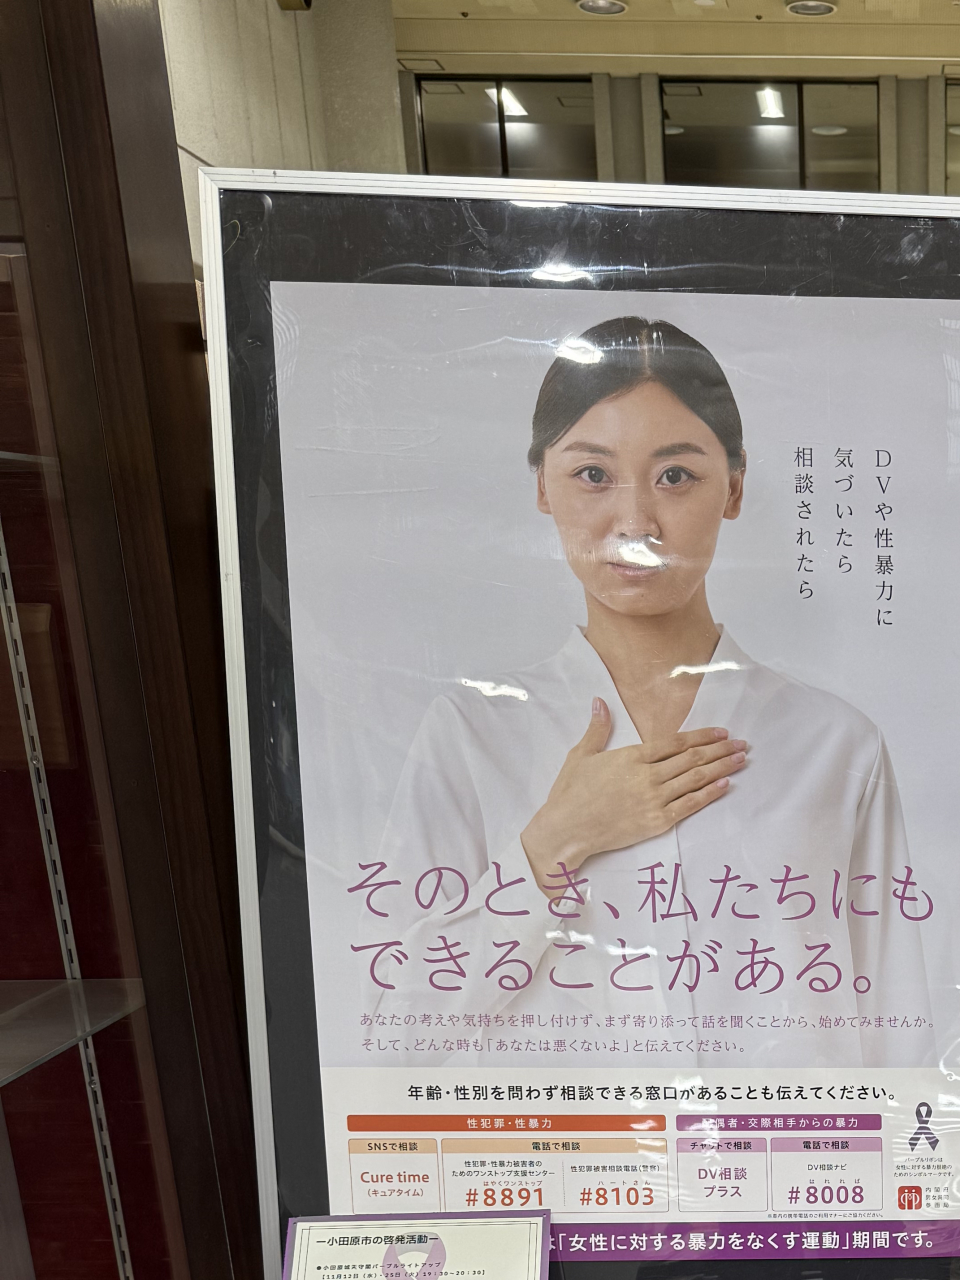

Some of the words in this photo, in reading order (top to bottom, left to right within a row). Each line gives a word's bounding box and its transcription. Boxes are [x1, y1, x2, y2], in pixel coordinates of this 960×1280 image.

[833, 447, 855, 576] 気づいたら
[792, 446, 816, 602] 相談されたら
[873, 448, 895, 628] DVや性暴力に
[346, 861, 935, 924] そのとき、私たちにも
[349, 934, 879, 995] できることがある。
[359, 1012, 935, 1031] あなたの考えや気持ちを押し付けず、まず寄り添って話を聞くことから、始めてみませんか。
[361, 1036, 745, 1054] そして、どんな時も「あなたは悪くないよ」と伝えてください。
[407, 1084, 896, 1102] 年齢・性別を問わず相談できる窓口があることも伝えてください。
[467, 1117, 553, 1129] 性犯罪・性暴力
[367, 1141, 419, 1152] SNSで相談
[531, 1141, 581, 1152] 電話で相談
[802, 1140, 850, 1150] 電話で相談
[464, 1160, 542, 1168] 性犯罪・性暴力被害者の
[807, 1163, 848, 1171] DV相談ナビ
[360, 1171, 394, 1184] Cure
[396, 1171, 430, 1184] time
[698, 1167, 748, 1181] DV相談
[466, 1188, 543, 1207] #8891
[580, 1187, 654, 1206] #8103
[704, 1186, 742, 1197] プラス
[788, 1185, 864, 1204] #8008
